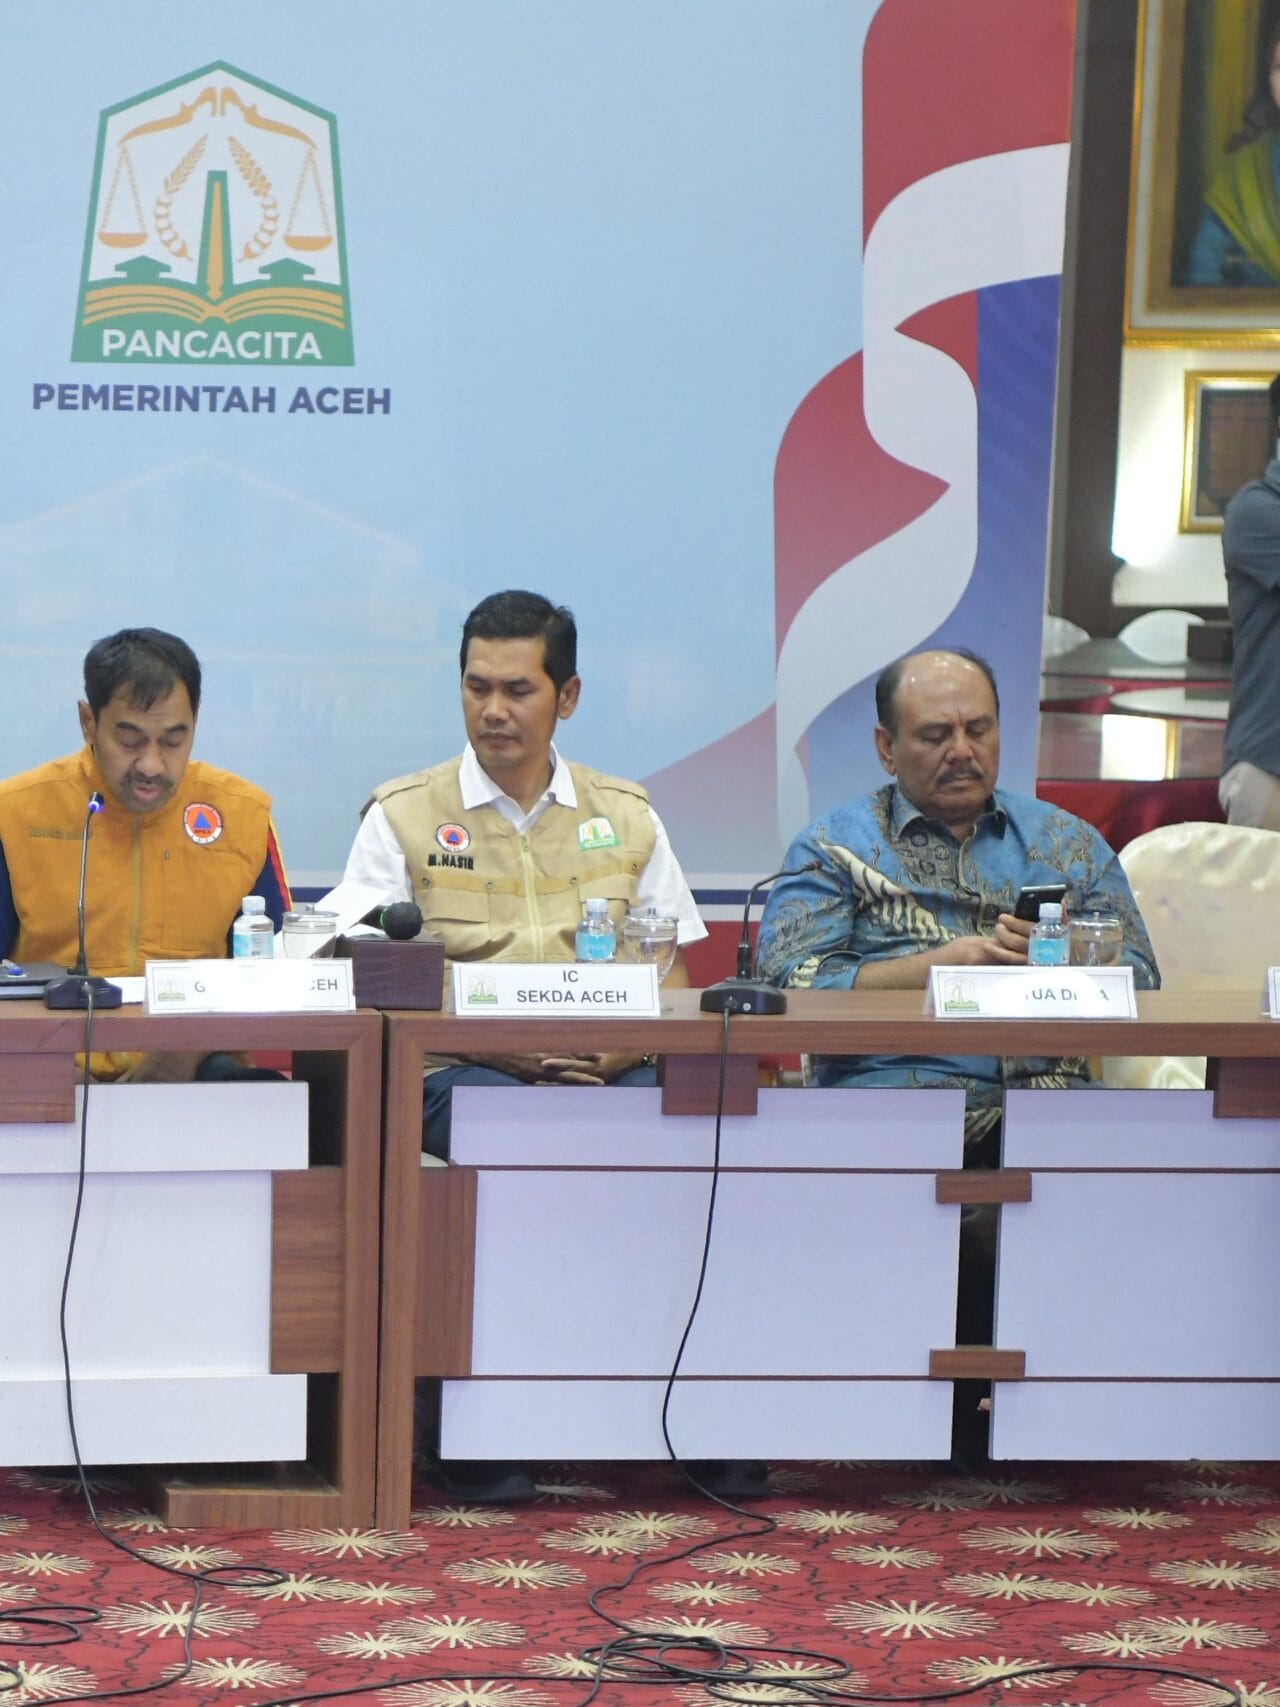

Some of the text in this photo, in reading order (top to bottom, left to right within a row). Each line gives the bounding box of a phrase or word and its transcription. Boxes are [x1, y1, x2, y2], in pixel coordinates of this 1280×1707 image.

[102, 329, 323, 360] PANCACITA
[32, 383, 392, 415] PEMERINTAH ACEH
[562, 969, 579, 983] IC
[516, 990, 628, 1003] SEKDA ACEH
